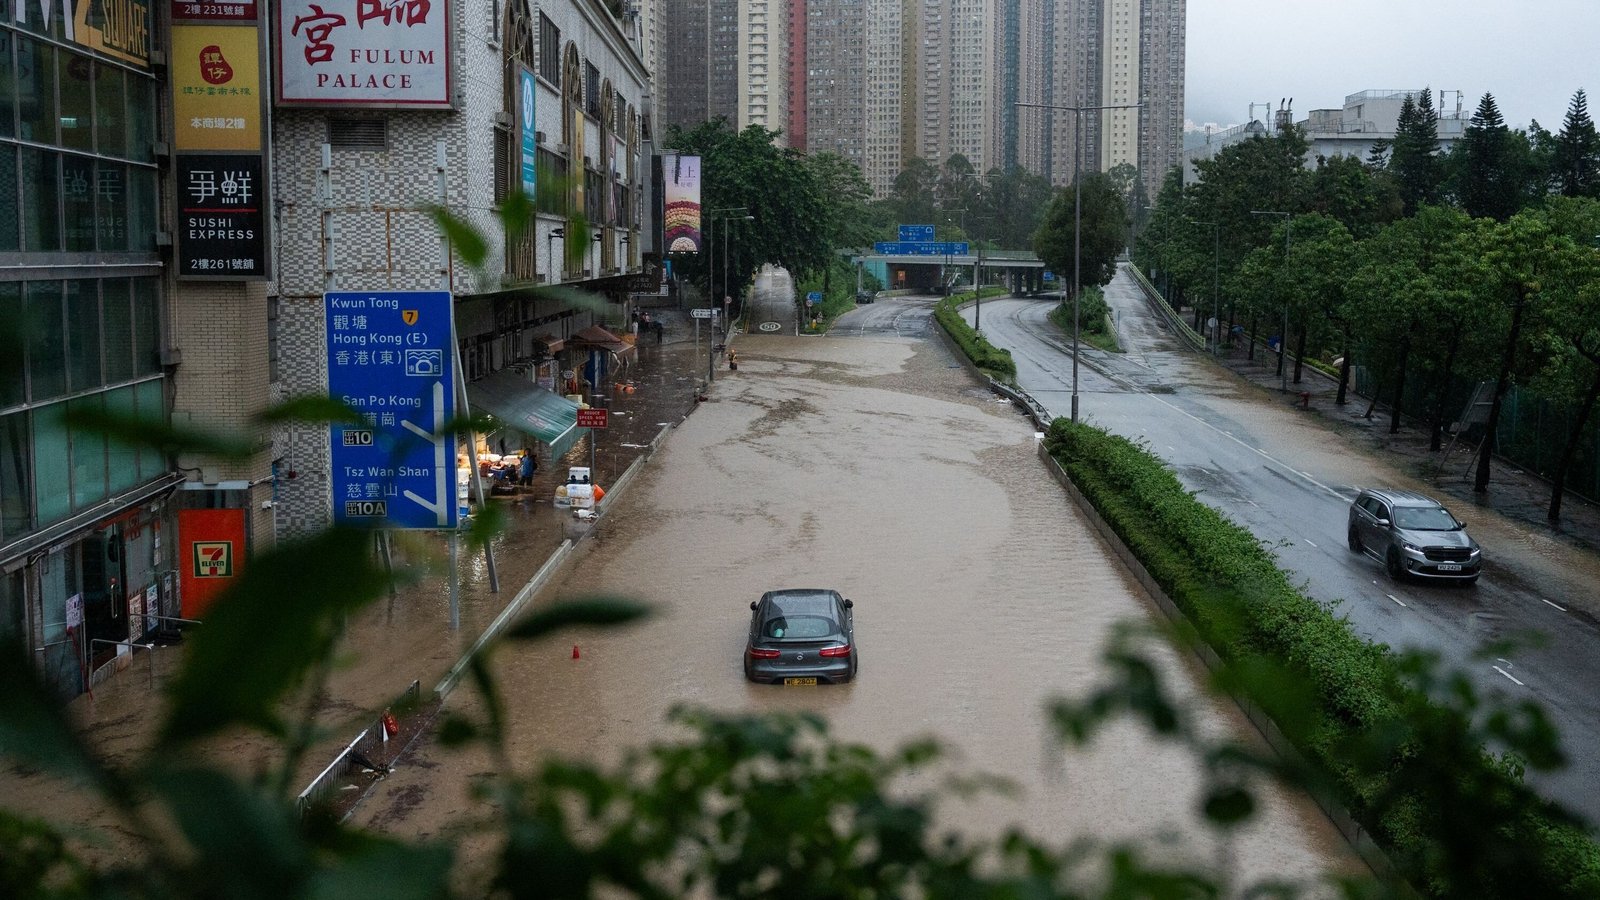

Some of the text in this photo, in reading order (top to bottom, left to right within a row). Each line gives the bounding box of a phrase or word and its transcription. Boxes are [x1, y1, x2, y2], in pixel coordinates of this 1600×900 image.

[184, 4, 201, 15] 2樓
[291, 4, 347, 66] 宮
[350, 49, 435, 65] FULUM
[316, 73, 413, 89] PALACE
[191, 117, 246, 129] 本商場2樓
[189, 218, 232, 228] SUSHI
[189, 229, 254, 240] EXPRESS
[331, 297, 399, 310] Kwun Tong
[333, 315, 367, 330] 觀塘
[406, 311, 414, 323] 7
[333, 332, 428, 346] Hong Kong (E)
[342, 395, 422, 408] San Po Kong
[355, 431, 372, 445] 10
[344, 466, 429, 477] Tsz Wan Shan
[346, 482, 398, 498] 慈雲山
[357, 502, 385, 515] 10A
